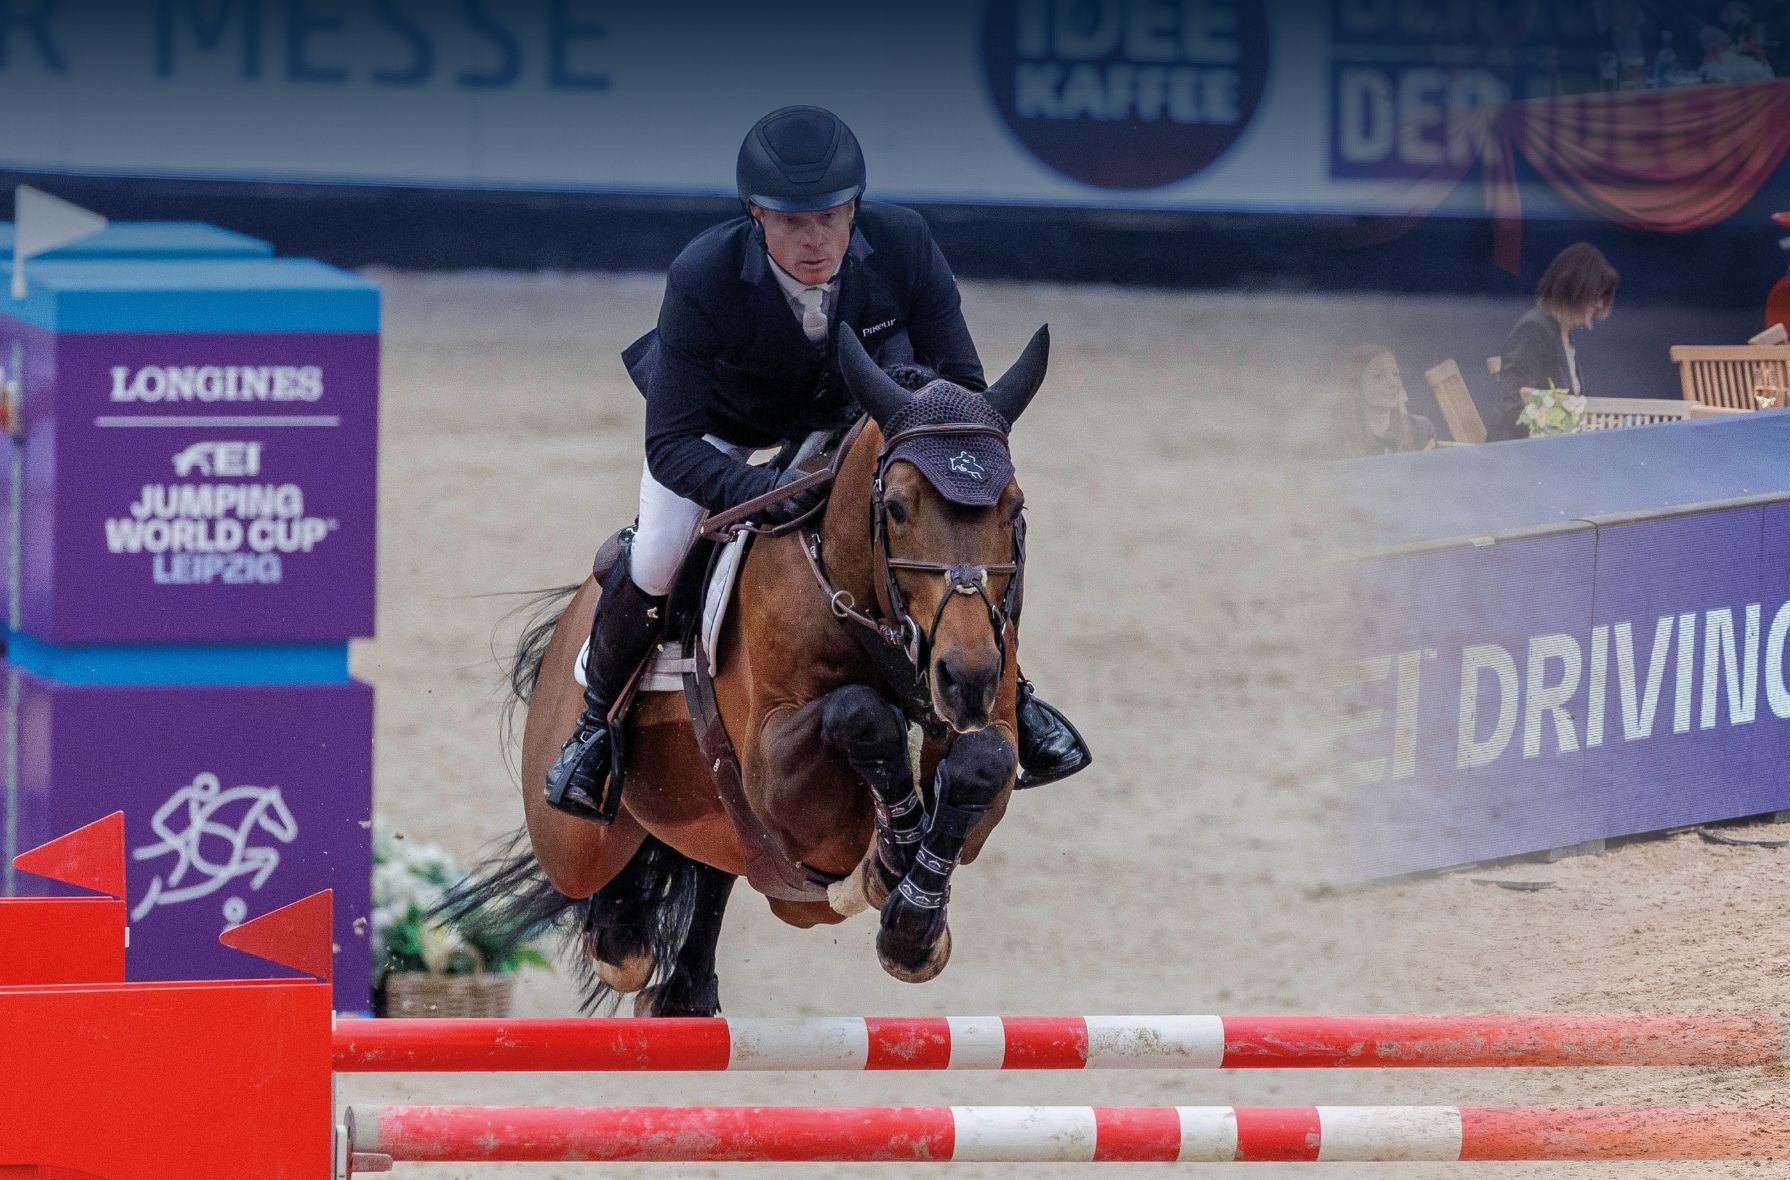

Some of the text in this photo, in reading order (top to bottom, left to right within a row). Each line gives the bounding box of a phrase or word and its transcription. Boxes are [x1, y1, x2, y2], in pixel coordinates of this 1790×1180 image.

[1013, 64, 1242, 125] KAFFEE
[1338, 66, 1509, 166] DER
[112, 366, 322, 401] LONGINES
[130, 484, 303, 520] JUMPING
[105, 520, 244, 553] WORLD
[153, 553, 283, 584] LEIPZIG
